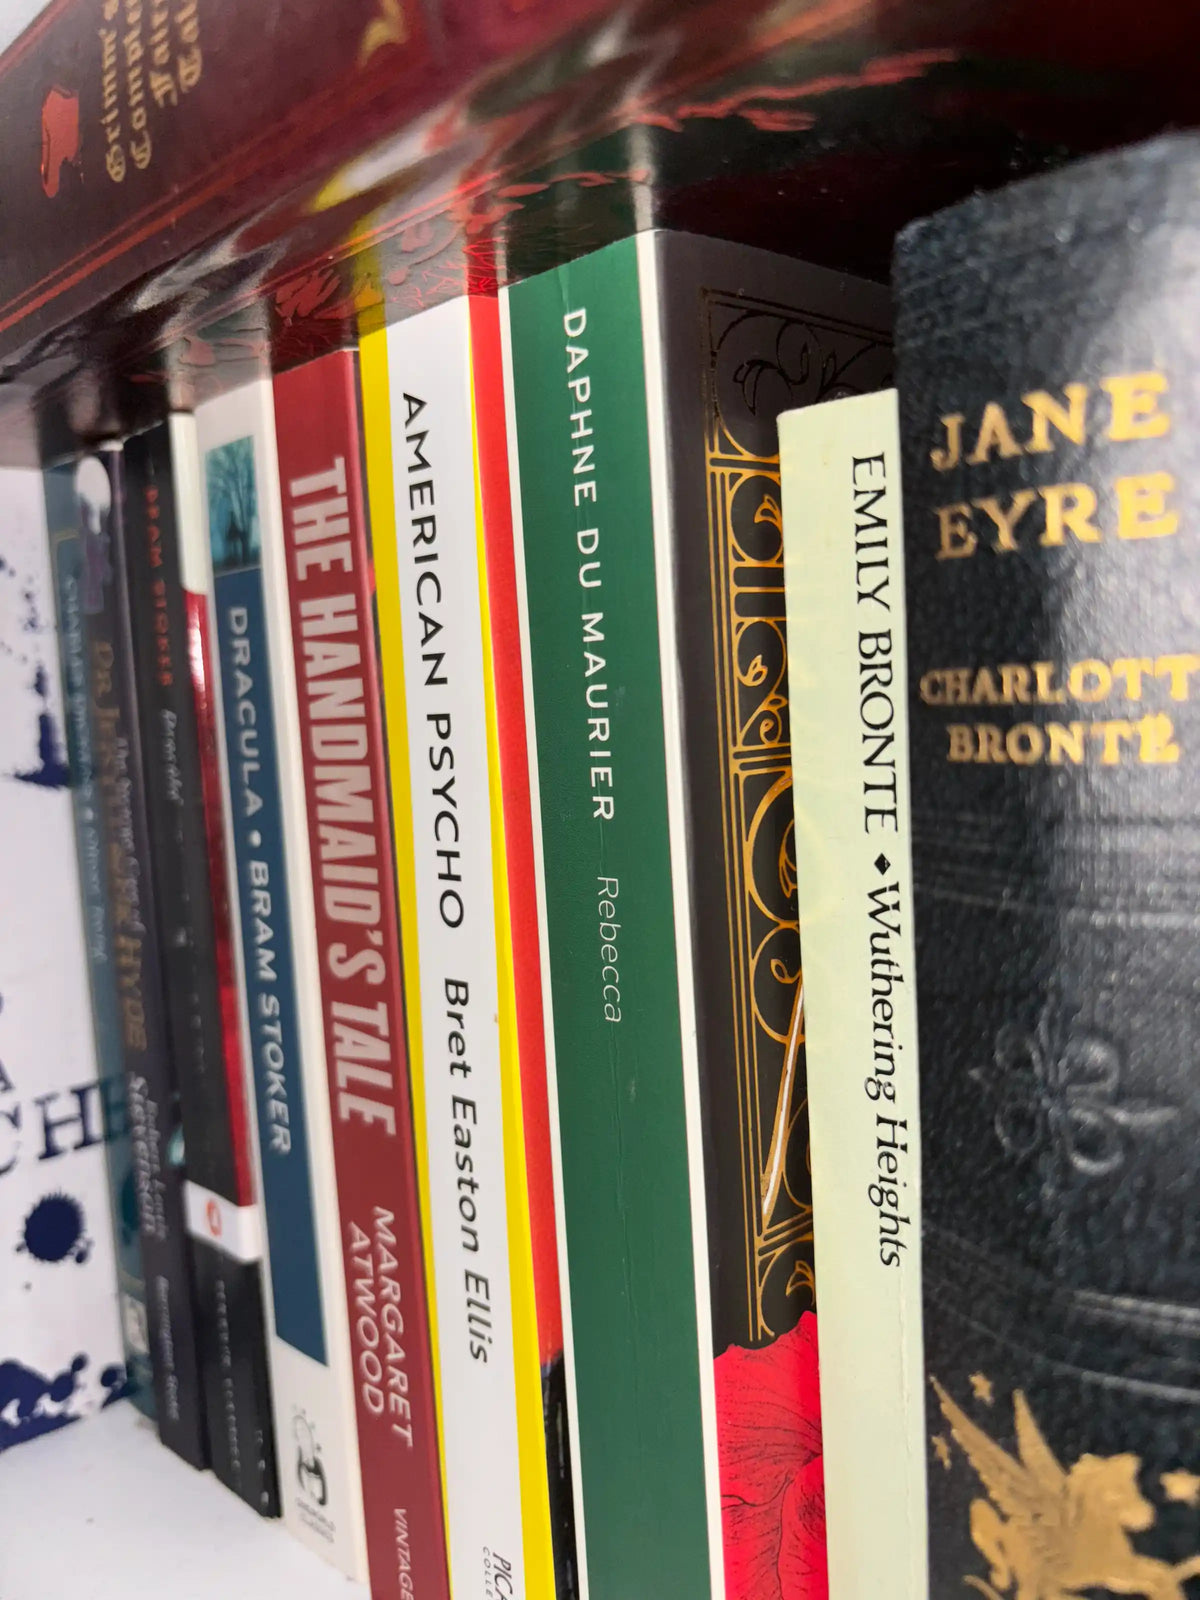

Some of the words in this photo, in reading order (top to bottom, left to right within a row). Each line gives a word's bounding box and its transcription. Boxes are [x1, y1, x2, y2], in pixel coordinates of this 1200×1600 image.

[563, 308, 597, 507] DAPHNE
[930, 372, 1171, 472] JANE
[289, 455, 353, 581] THE
[577, 528, 602, 588] DU
[852, 452, 891, 612] EMILY
[935, 470, 1179, 561] EYRE
[229, 606, 264, 817] DRACULA
[402, 392, 449, 686] AMERICAN
[426, 713, 464, 928] PSYCHO
[581, 612, 615, 820] MAURIER
[858, 629, 898, 834] BRONTE
[299, 593, 387, 985] HANDMAID'S
[250, 859, 278, 982] BRAM
[597, 876, 622, 1024] Rebecca
[865, 881, 905, 1104] Wuthering
[260, 993, 292, 1156] STOKER
[331, 1001, 396, 1136] TALE
[444, 978, 472, 1078] Bret
[451, 1094, 480, 1253] Easton
[868, 1114, 911, 1268] Heights
[349, 1221, 385, 1415] ATWOOD
[373, 1205, 413, 1448] MARGARET
[464, 1269, 493, 1364] Ellis
